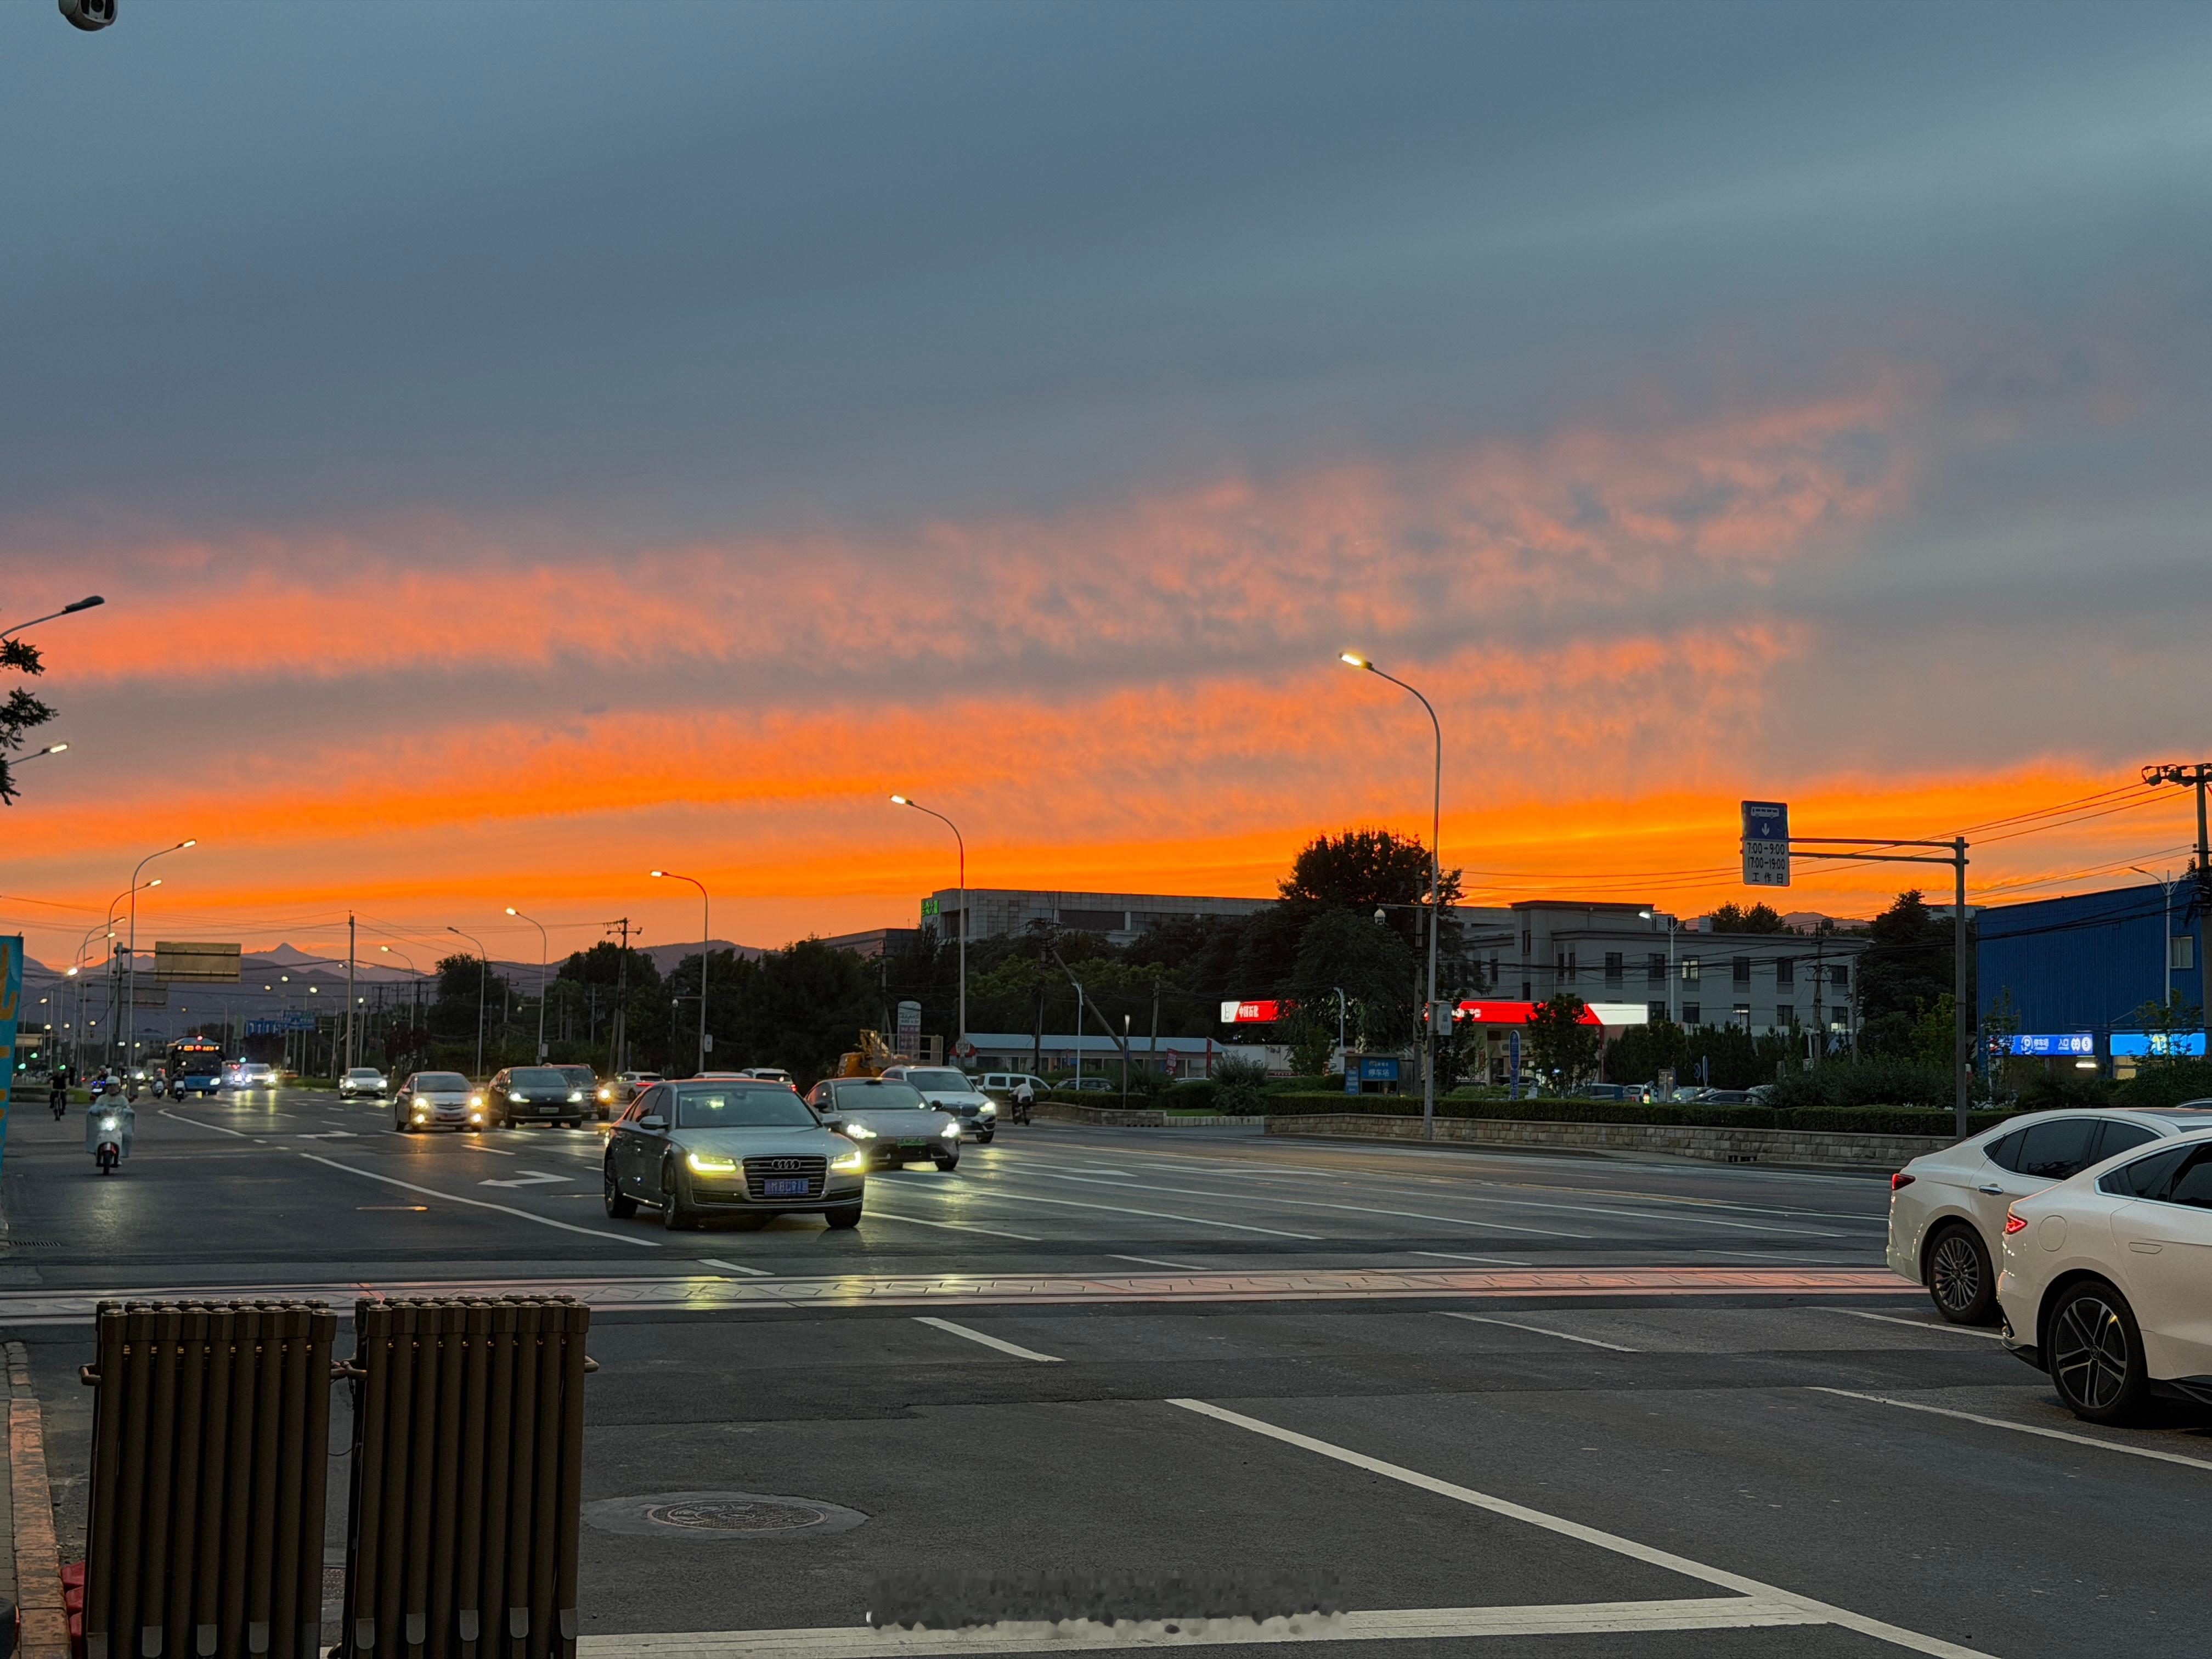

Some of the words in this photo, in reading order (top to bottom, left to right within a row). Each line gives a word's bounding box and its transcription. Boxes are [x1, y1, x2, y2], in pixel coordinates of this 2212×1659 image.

[1752, 872, 1783, 884] 工作日
[1239, 1005, 1259, 1018] 中国石化
